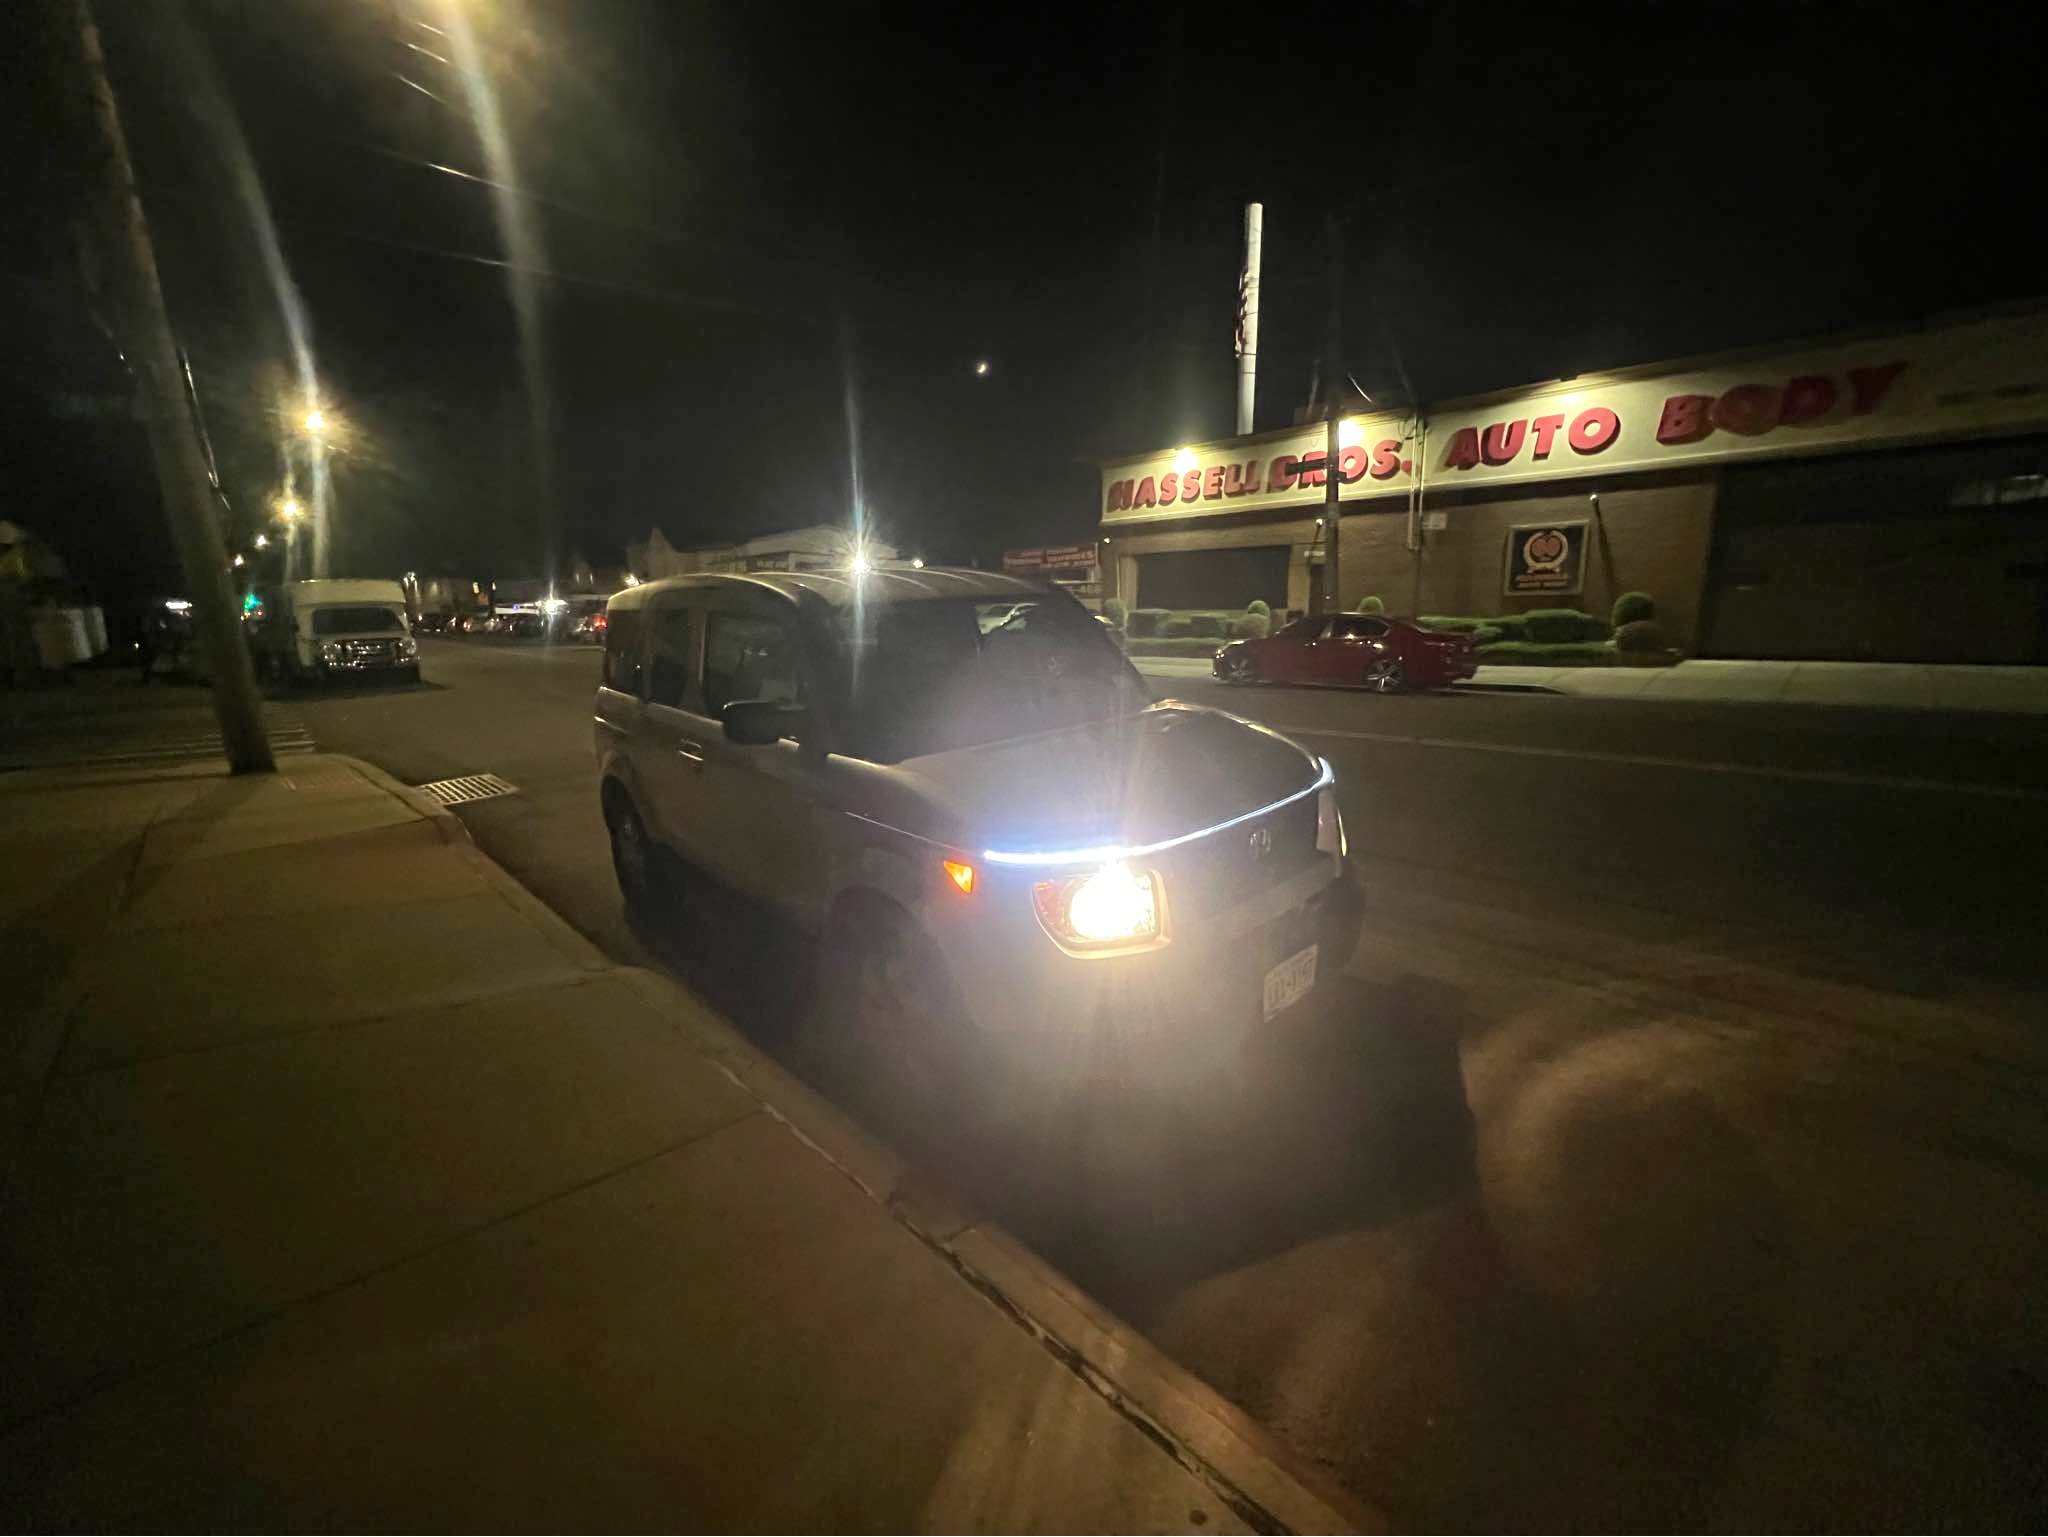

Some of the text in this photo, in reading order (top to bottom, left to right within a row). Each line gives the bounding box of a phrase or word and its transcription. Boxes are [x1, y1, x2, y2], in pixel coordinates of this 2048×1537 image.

[1107, 460, 1259, 512] HASSELL
[1446, 407, 1621, 469] AUTO
[1656, 360, 1911, 446] BODY
